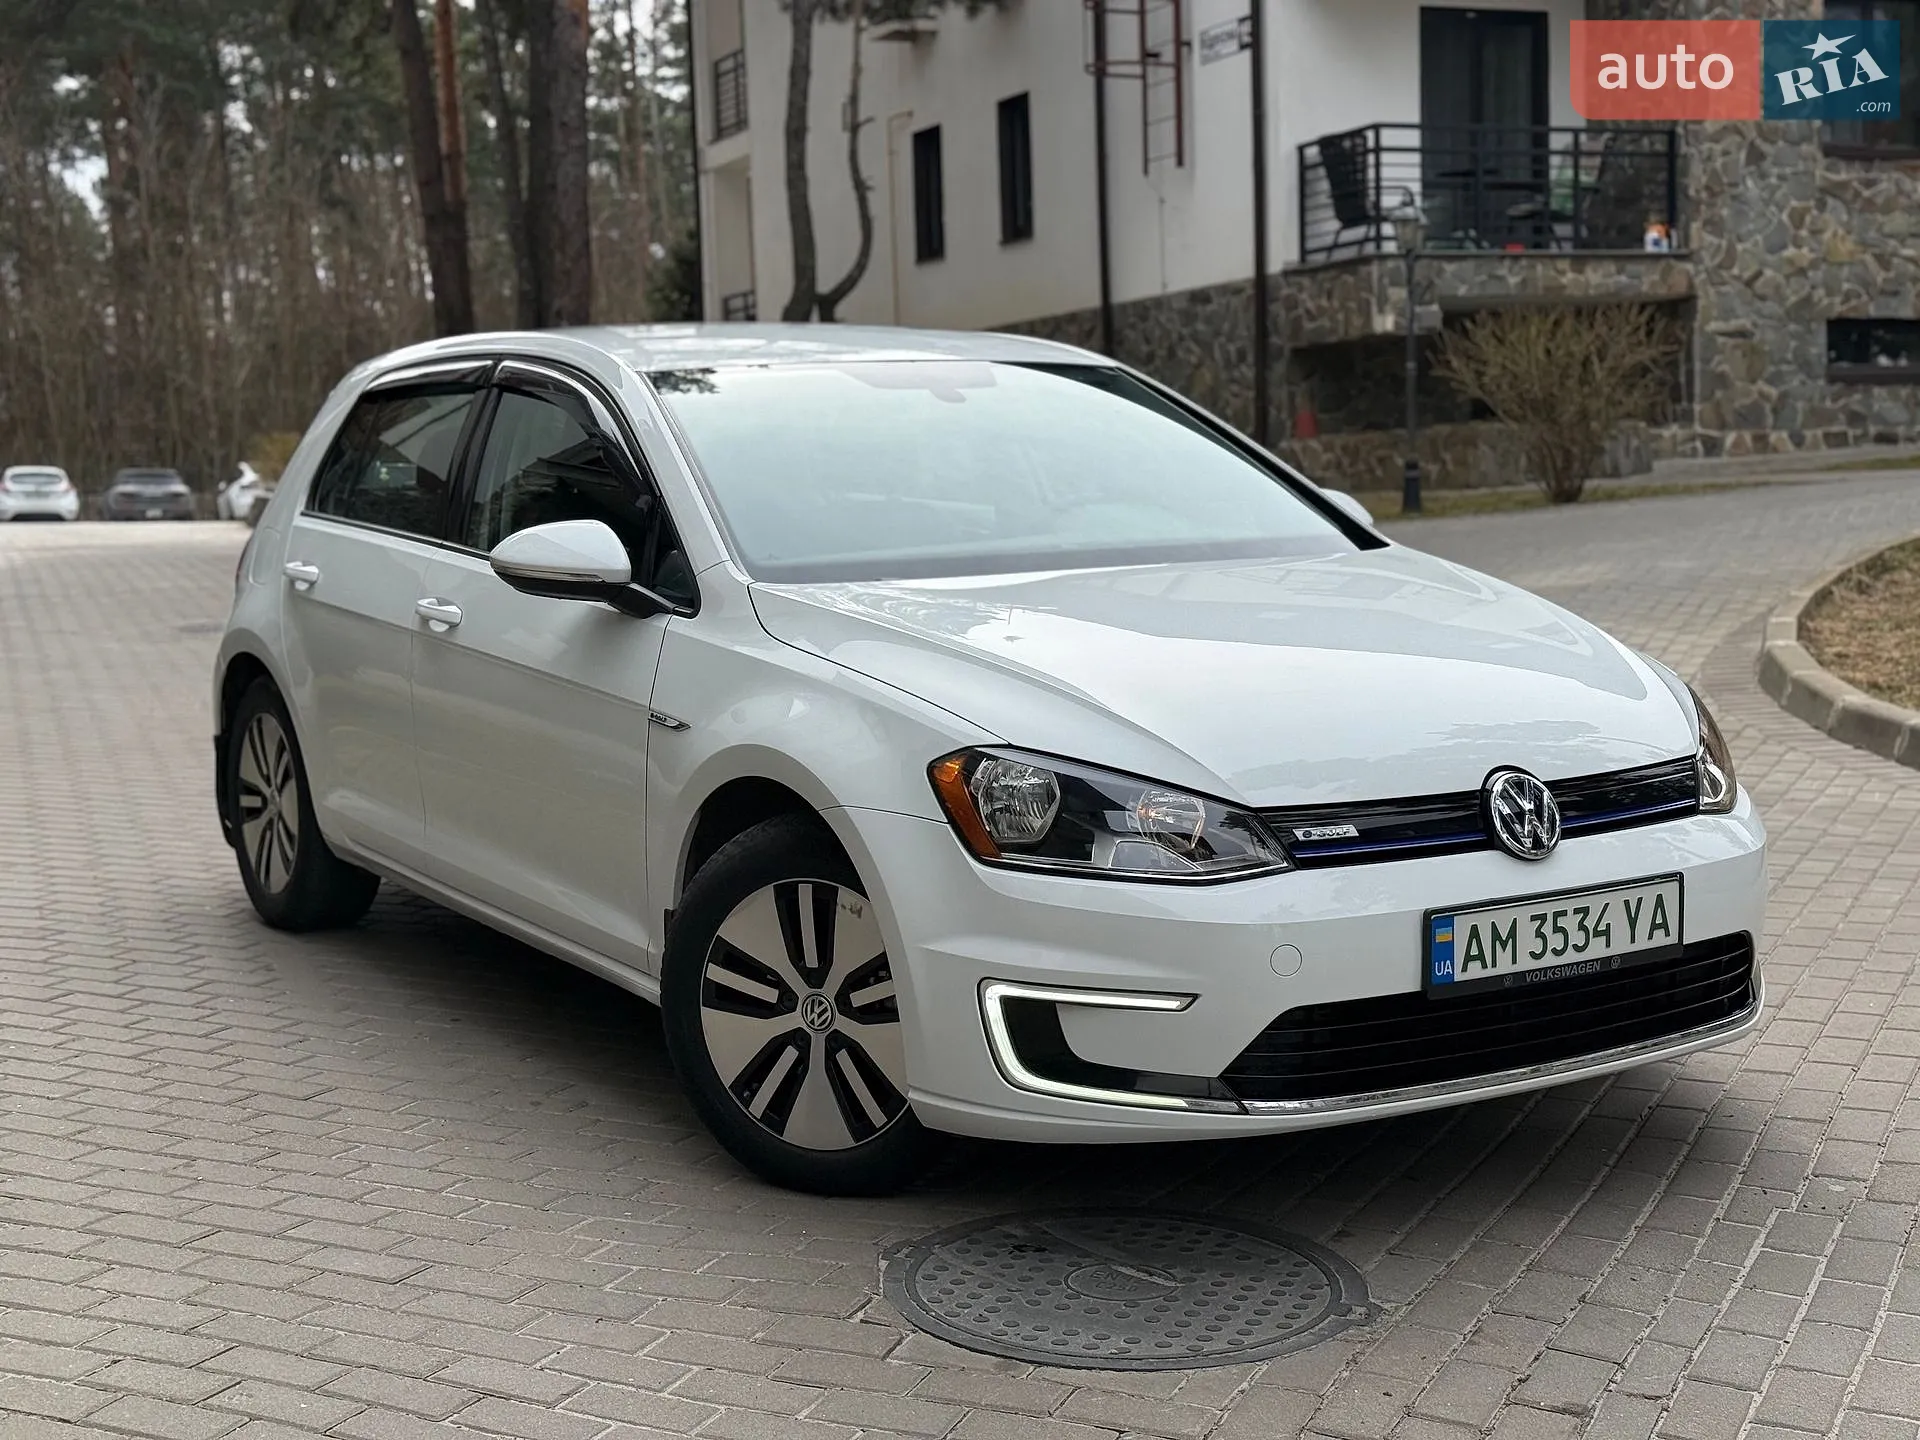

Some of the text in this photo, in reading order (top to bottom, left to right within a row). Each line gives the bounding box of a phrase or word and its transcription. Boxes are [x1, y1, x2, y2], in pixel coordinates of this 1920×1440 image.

[1461, 893, 1671, 973] AM 3534 YA
[1435, 961, 1453, 976] UA
[1525, 960, 1601, 982] VOLKSWAGEN
